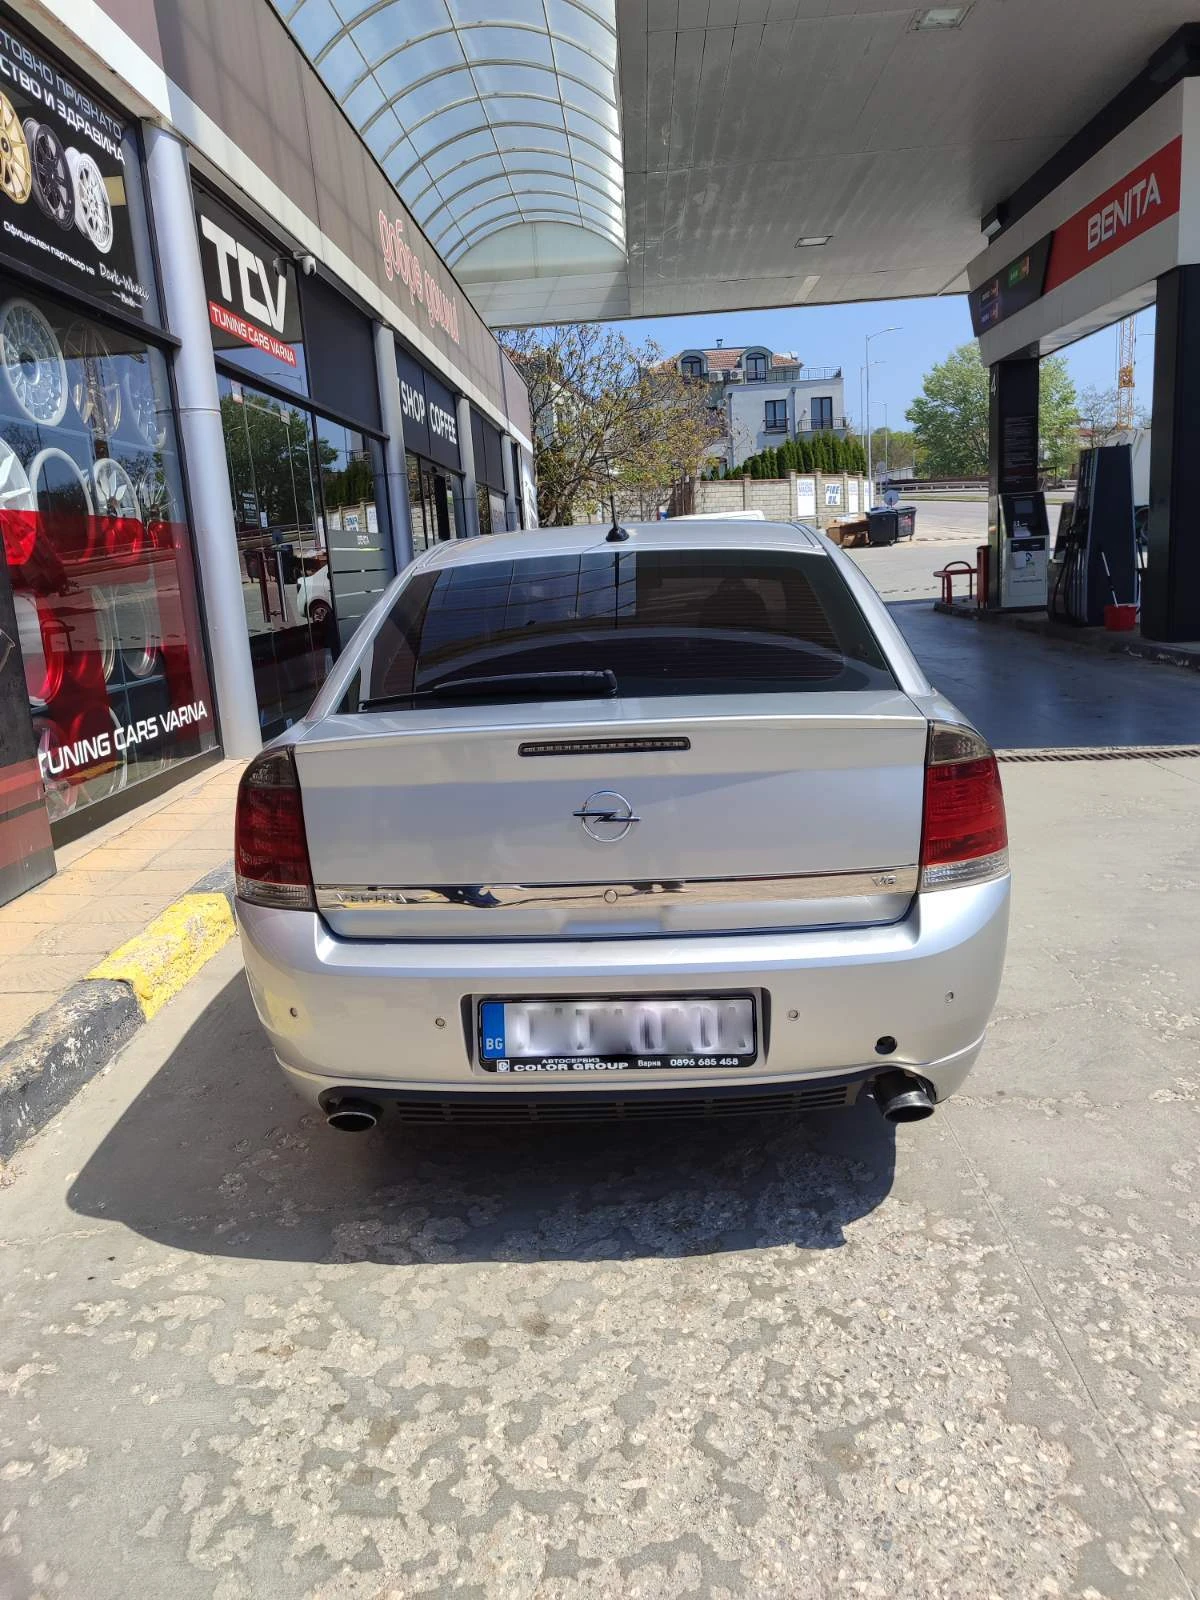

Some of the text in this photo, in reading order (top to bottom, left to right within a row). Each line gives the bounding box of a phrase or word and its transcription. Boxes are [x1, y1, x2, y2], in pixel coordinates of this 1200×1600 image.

[0, 28, 122, 140] ТОВНО ПРИЗНАТО
[43, 87, 56, 111] И
[56, 98, 126, 166] ЗДРАВИНА
[1087, 172, 1161, 251] BENITA
[3, 220, 51, 253] Официален
[86, 264, 96, 276] на
[201, 214, 287, 334] TCV
[211, 306, 295, 365] TUNING CARS VARNA
[400, 380, 457, 445] SHOP COFFEE
[38, 700, 208, 779] TUNING CARS VARNA
[485, 1038, 503, 1050] BG
[513, 1063, 569, 1072] COLOR
[572, 1062, 629, 1071] GROUP
[637, 1057, 739, 1068] Варна 0896 685 458
